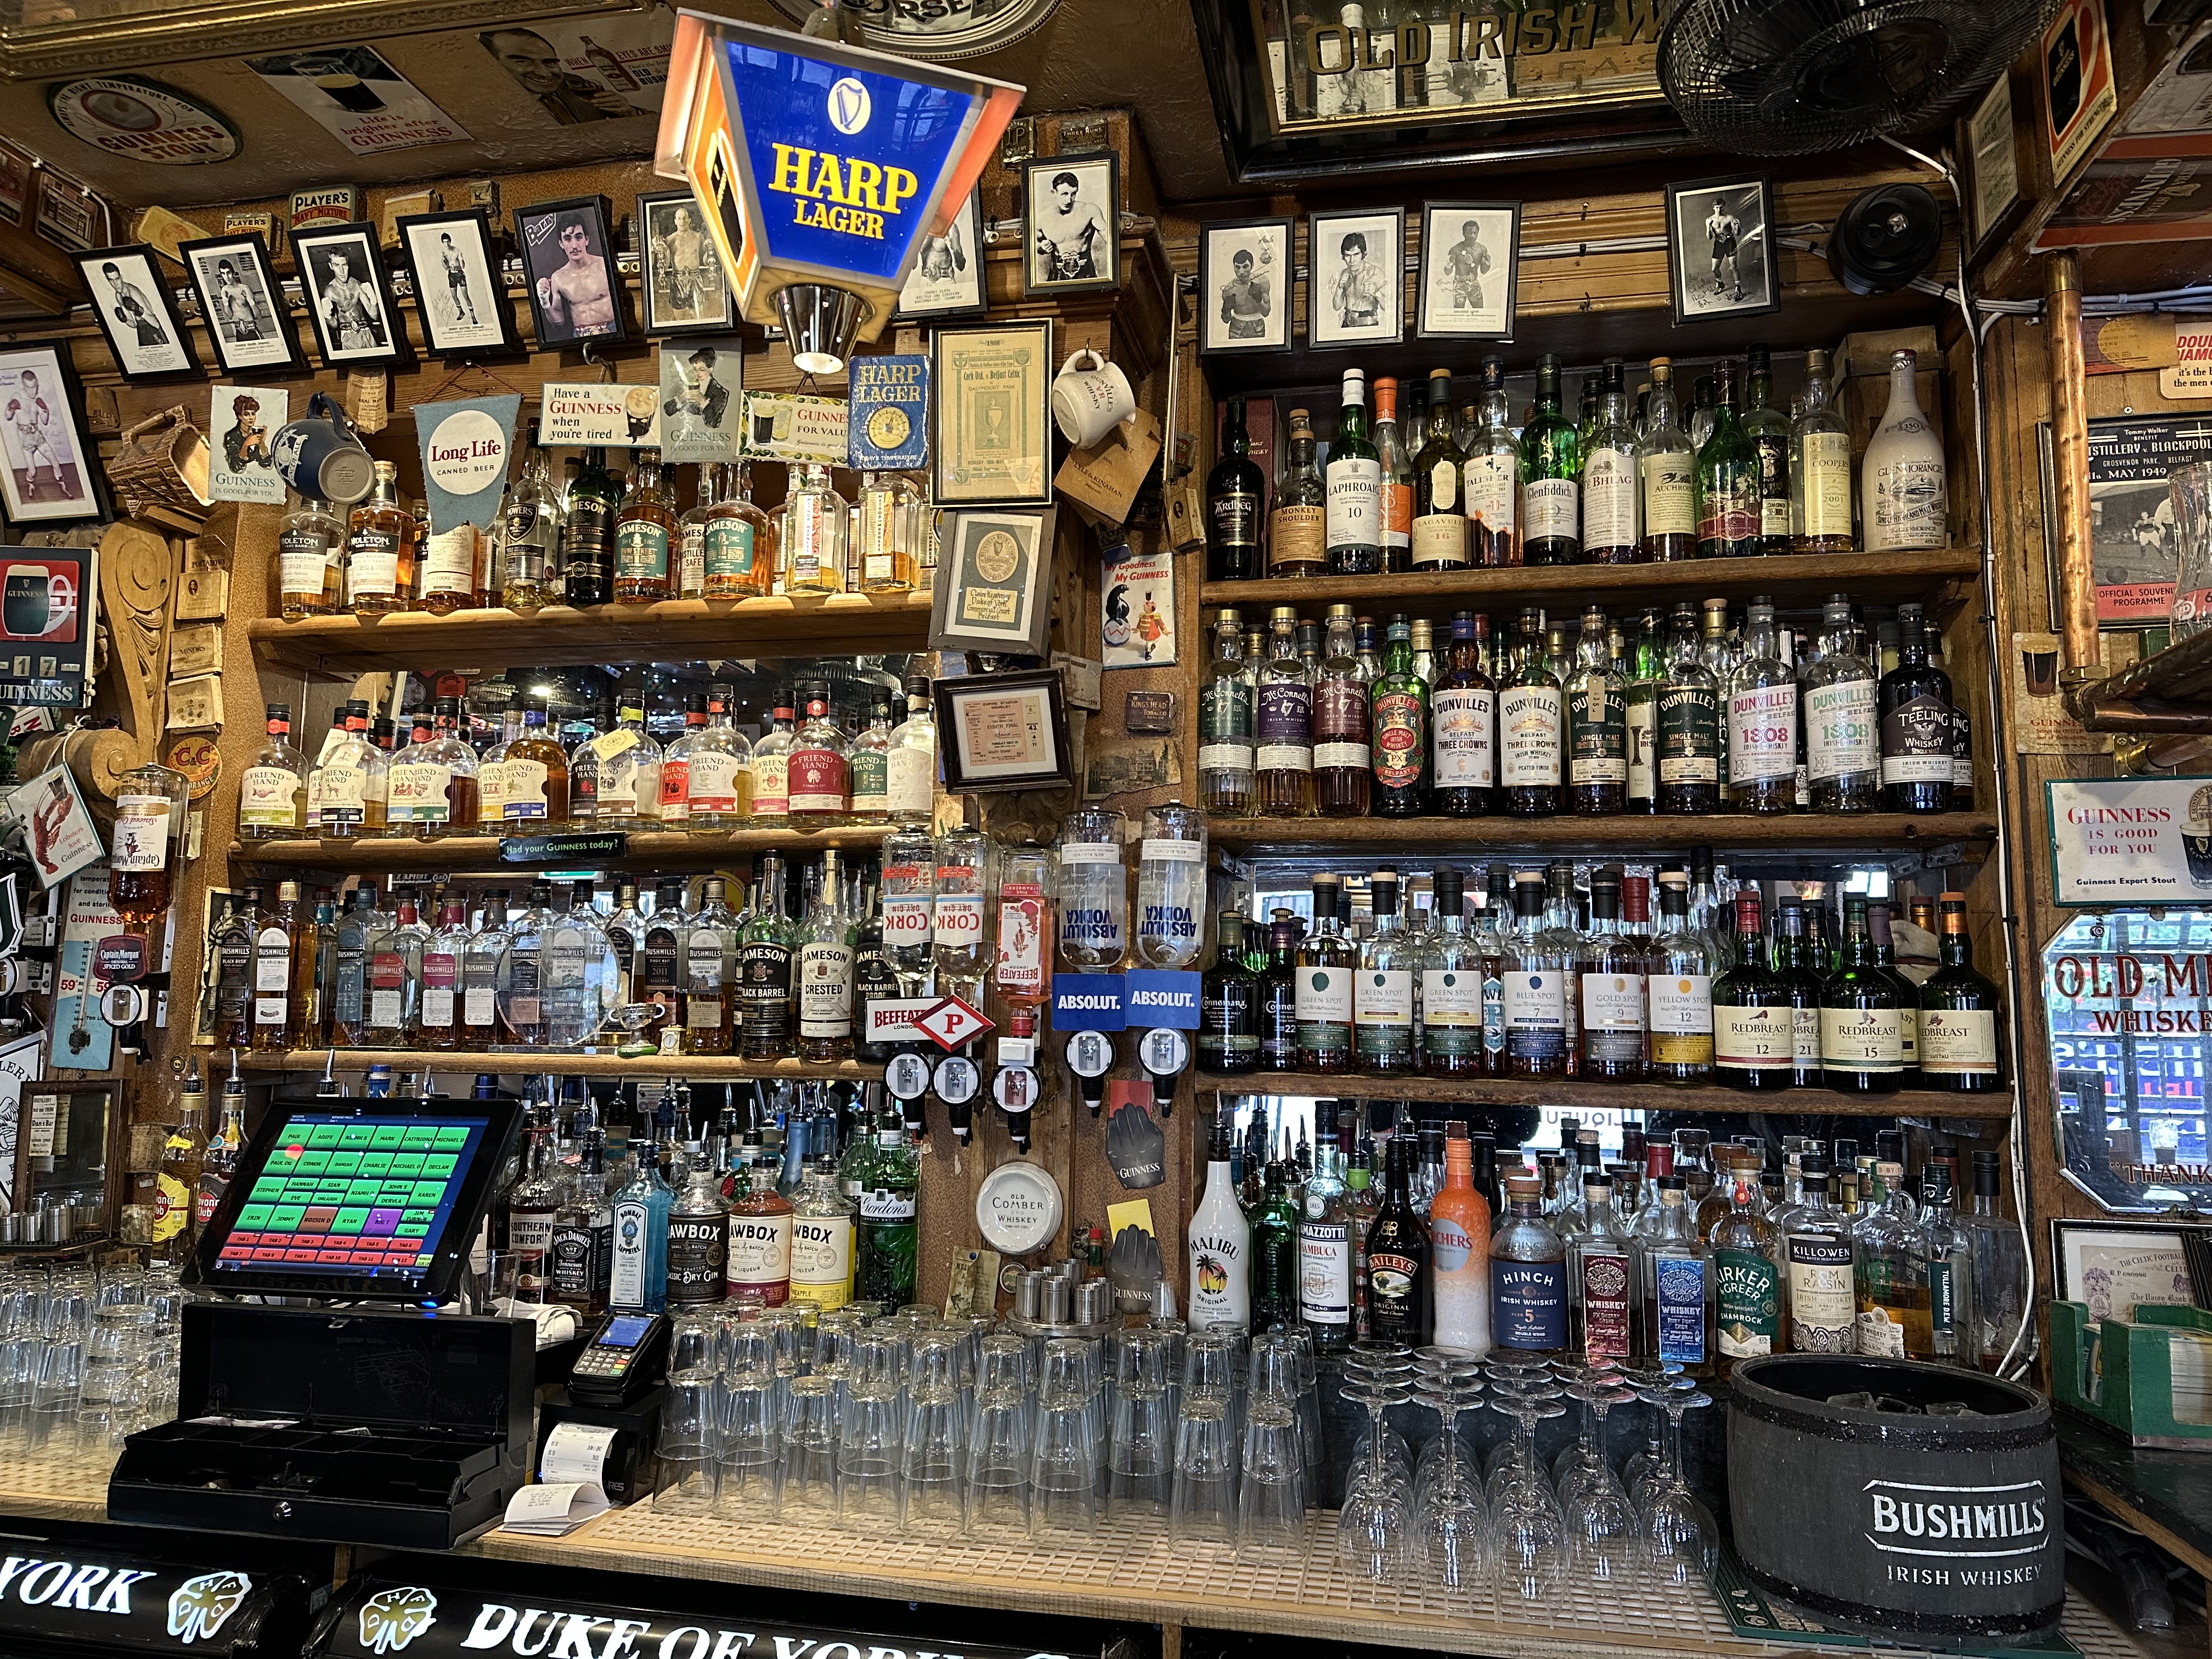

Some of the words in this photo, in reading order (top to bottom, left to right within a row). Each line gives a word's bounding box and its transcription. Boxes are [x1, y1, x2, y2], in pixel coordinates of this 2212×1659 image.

[1306, 21, 1432, 77] OLD
[1448, 2, 1599, 64] IRISH
[564, 57, 590, 67] WHEN
[616, 49, 637, 60] EYES
[639, 47, 654, 57] ARE
[358, 115, 388, 124] Life
[340, 124, 398, 136] brighter
[405, 119, 439, 128] after
[141, 142, 219, 159] STOUT
[769, 142, 918, 216] HARP
[295, 191, 349, 212] PLAYER'S
[225, 219, 266, 229] PLAYER'S
[793, 199, 885, 240] LAGER
[858, 364, 922, 385] HARP
[2179, 368, 2191, 376] it's
[2193, 368, 2207, 376] the
[554, 388, 579, 399] Have
[858, 385, 922, 403] LAGER
[552, 417, 580, 426] when
[549, 429, 582, 441] you're
[586, 428, 612, 439] tired
[432, 445, 469, 463] Long
[471, 440, 501, 458] Life
[437, 467, 469, 476] CANNED
[1877, 464, 1944, 477] GLENMORANGIE
[2108, 469, 2136, 478] MAY
[2142, 468, 2166, 477] 1949
[215, 473, 275, 489] GUINNESS
[225, 488, 245, 496] GOOD
[1527, 484, 1573, 500] Glenfiddich
[506, 507, 534, 516] POWERS
[1281, 507, 1317, 516] MONKEY
[1347, 507, 1362, 518] 10
[1278, 515, 1320, 523] SHOULDER
[618, 524, 662, 538] JAMESON
[1104, 562, 1116, 572] My
[1118, 561, 1156, 571] Goodness
[1114, 573, 1128, 583] My
[1130, 570, 1169, 580] GUINNESS
[7, 589, 46, 599] GUINNESS
[2113, 597, 2165, 607] PROGRAMME
[1437, 699, 1489, 715] DUNVILLE'S
[1505, 699, 1558, 716] DUNVILLE'S
[1898, 713, 1948, 726] TEELING
[1743, 727, 1788, 742] 1808
[1438, 741, 1457, 749] THREE
[1458, 740, 1488, 749] CROWNS
[1905, 737, 1943, 748] WHISKEY
[691, 757, 725, 766] FRIEND
[802, 761, 829, 770] HAND
[59, 826, 84, 845] Lobsters
[2088, 829, 2104, 839] IS
[2114, 828, 2158, 839] GOOD
[68, 838, 81, 849] love
[506, 845, 522, 854] Had
[524, 844, 544, 854] your
[546, 842, 587, 851] GUINNESS
[589, 839, 618, 850] today?
[2089, 845, 2119, 855] FOR
[2128, 844, 2157, 854] YOU
[61, 841, 94, 863] Guinness
[885, 915, 928, 931] CORK
[1065, 910, 1113, 924] VODKA
[1062, 923, 1117, 939] ABSOLUT
[1140, 919, 1197, 937] ABSOLUT
[646, 947, 676, 956] BUSHMILLS
[803, 950, 849, 963] JAMESON
[1000, 968, 1039, 980] BEEFEATER
[2055, 955, 2145, 999] OLD
[805, 984, 843, 995] CRESTED
[1596, 994, 1620, 1002] GOLD
[1533, 1008, 1541, 1017] 7
[944, 1013, 964, 1034] P
[1731, 1023, 1787, 1034] REDBREAST
[1838, 1026, 1898, 1036] REDBREAST
[1756, 1043, 1769, 1054] 12
[1864, 1046, 1878, 1058] 15
[1119, 1163, 1160, 1179] GUINNESS
[861, 1195, 907, 1216] Gordon's
[992, 1196, 1043, 1210] COMBER
[998, 1214, 1038, 1224] WHISKEY
[511, 1221, 551, 1233] SOUTHERN
[553, 1232, 569, 1246] JACK
[568, 1232, 591, 1247] DANIEL'S
[1190, 1237, 1240, 1260] MALIBU
[1793, 1245, 1850, 1257] KILLOWEN
[1369, 1256, 1415, 1273] BAILEYS
[1503, 1272, 1554, 1286] HINCH
[1197, 1295, 1228, 1305] ORIGINAL
[1500, 1296, 1521, 1306] IRISH
[1522, 1298, 1558, 1306] WHISKEY
[1525, 1309, 1534, 1323] 5
[1720, 1312, 1763, 1325] SHAMROCK
[1871, 1494, 2046, 1540] BUSHMILLS
[1887, 1565, 1951, 1587] IRISH
[1960, 1564, 2044, 1587] WHISKEY
[0, 1555, 157, 1614] YORK
